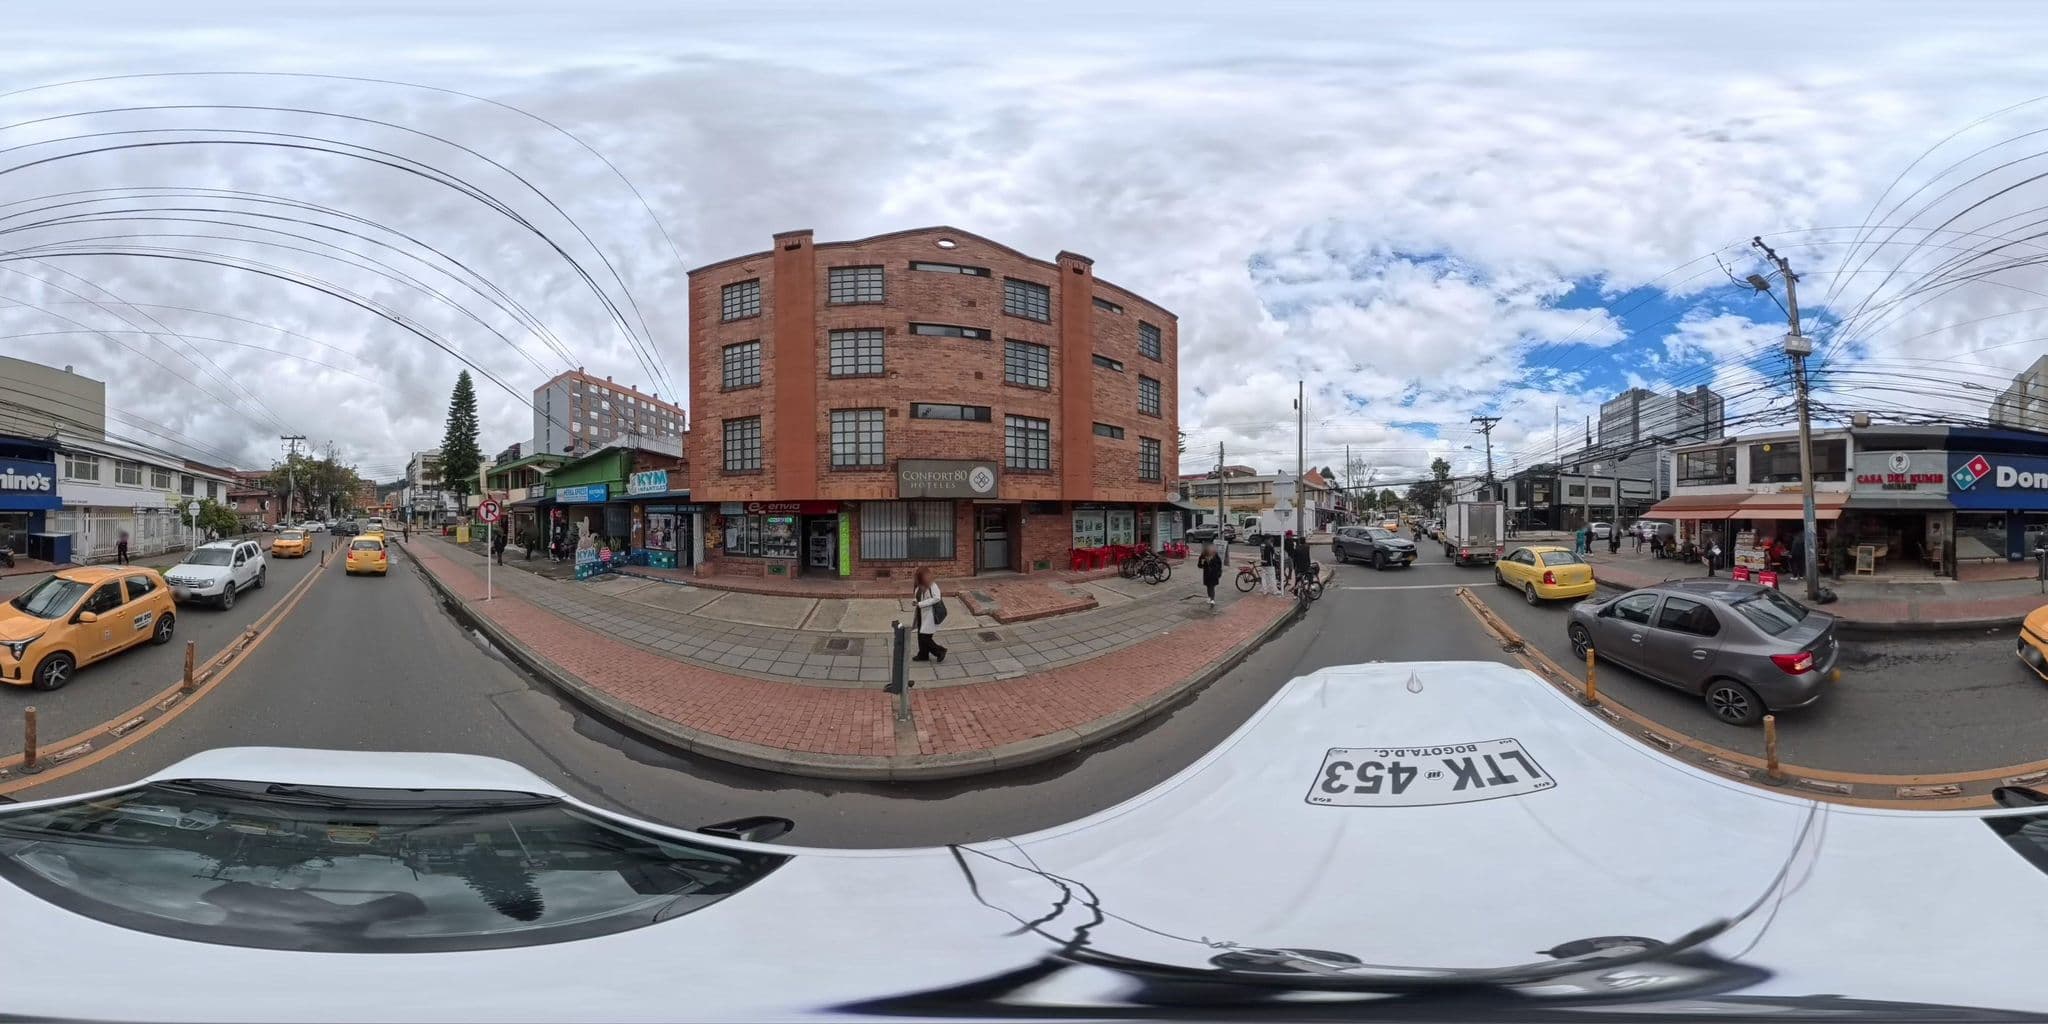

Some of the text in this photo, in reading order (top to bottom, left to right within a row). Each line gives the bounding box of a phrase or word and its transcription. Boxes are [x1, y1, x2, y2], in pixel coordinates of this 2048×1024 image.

[638, 471, 667, 486] KYM
[1856, 474, 1883, 484] CASA
[1887, 473, 1907, 483] DEL
[1321, 750, 1542, 795] LTK 453
